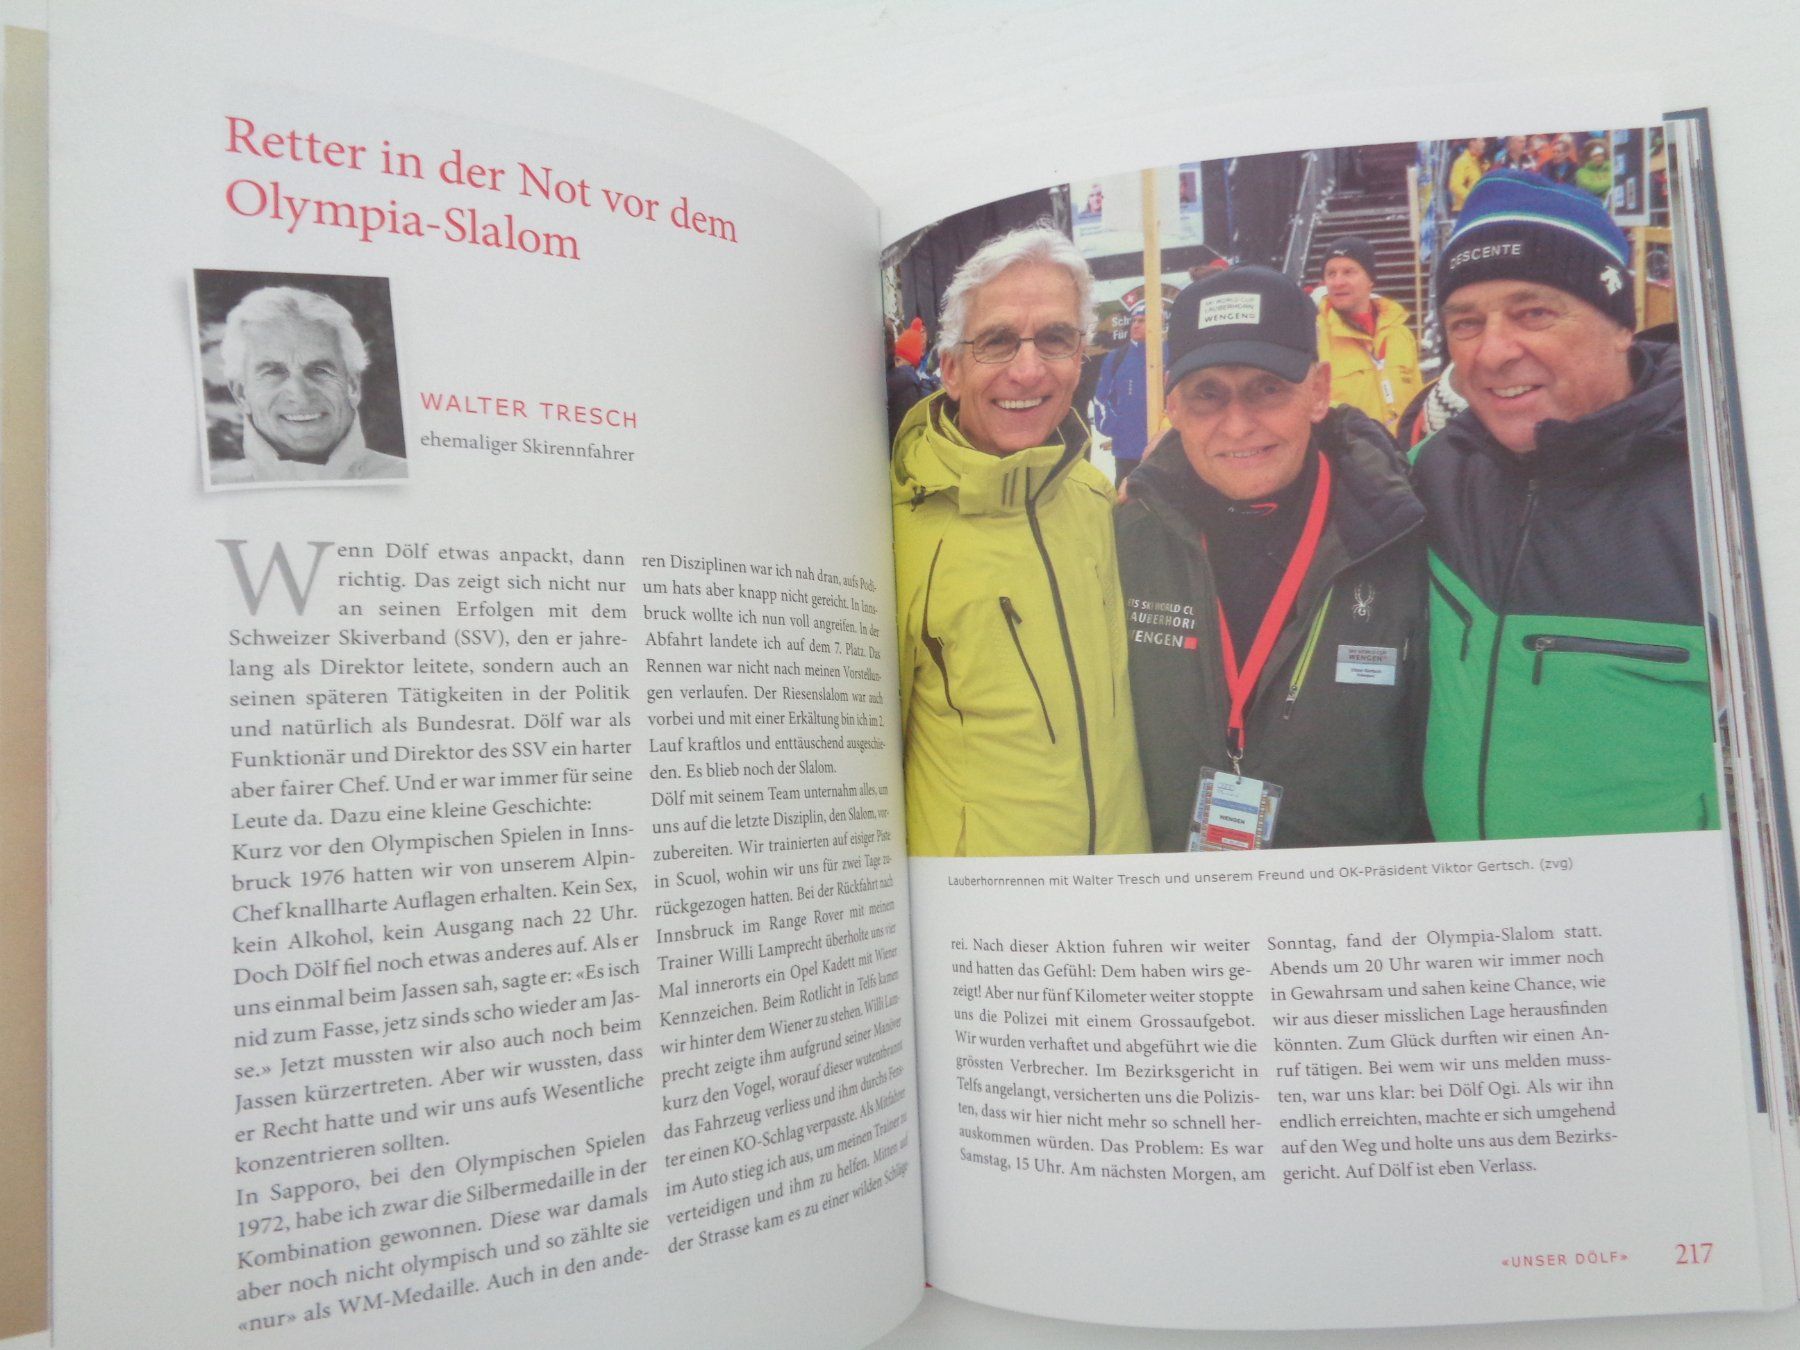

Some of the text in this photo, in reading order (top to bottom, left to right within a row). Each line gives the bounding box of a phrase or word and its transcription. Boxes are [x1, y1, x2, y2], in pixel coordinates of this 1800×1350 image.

[224, 115, 739, 244] Retter in der Not vor dem
[224, 178, 580, 261] Olympia-Slalom
[1449, 243, 1521, 270] DESCENTE
[1204, 312, 1248, 323] WENGEN
[419, 391, 637, 429] WALTER TRESCH
[420, 430, 636, 462] ehemaliger Skirennfahrer
[385, 542, 430, 560] Dölf
[437, 546, 490, 561] etwas
[499, 547, 574, 567] anpackt,
[582, 548, 625, 566] dann
[228, 628, 628, 651] Schweizer Skiverband (SSV), den er jahre-
[645, 657, 882, 682] Rennen war nicht nach meinen Vorstellun-
[229, 683, 632, 711] seinen späteren Tätigkeiten in der Politik
[648, 759, 837, 780] den. Es blieb noch der Slalom.
[231, 795, 592, 830] Leute da. Dazu eine kleine Geschichte:
[231, 849, 636, 892] bruck 1976 hatten wir von unserem Alpin-
[947, 856, 1574, 887] Lauberhornrennen mit Walter Tresch und unserem Freund und OK-Präsident Viktor Gertsch. (zvg)
[232, 903, 638, 955] kein Alkohol, kein Ausgang nach 22 Uhr.
[1267, 925, 1603, 954] Sonntag, fand der Olympia-Slalom statt.
[950, 937, 1251, 954] rei. Nach dieser Aktion fuhren wir weiter
[953, 1007, 1256, 1033] uns die Polizei mit einem Grossaufgebot.
[1271, 999, 1608, 1027] wir aus dieser misslichen Lage herausfinden
[234, 1045, 644, 1115] Jassen kürzertreten. Aber wir wussten, dass
[955, 1054, 1260, 1084] grössten Verbrecher. Im Bezirksgericht in
[1279, 1100, 1617, 1129] endlich erreichten, machte er sich umgehend
[236, 1130, 646, 1207] In Sapporo, bei den Olympischen Spielen
[1282, 1157, 1537, 1186] gericht. Auf Dölf ist eben Verlass.
[1501, 1249, 1629, 1269] «UNSER DÖLF»
[1674, 1241, 1715, 1266] 217
[237, 1245, 649, 1332] «nur» als WM-Medaille. Auch in den ande-
